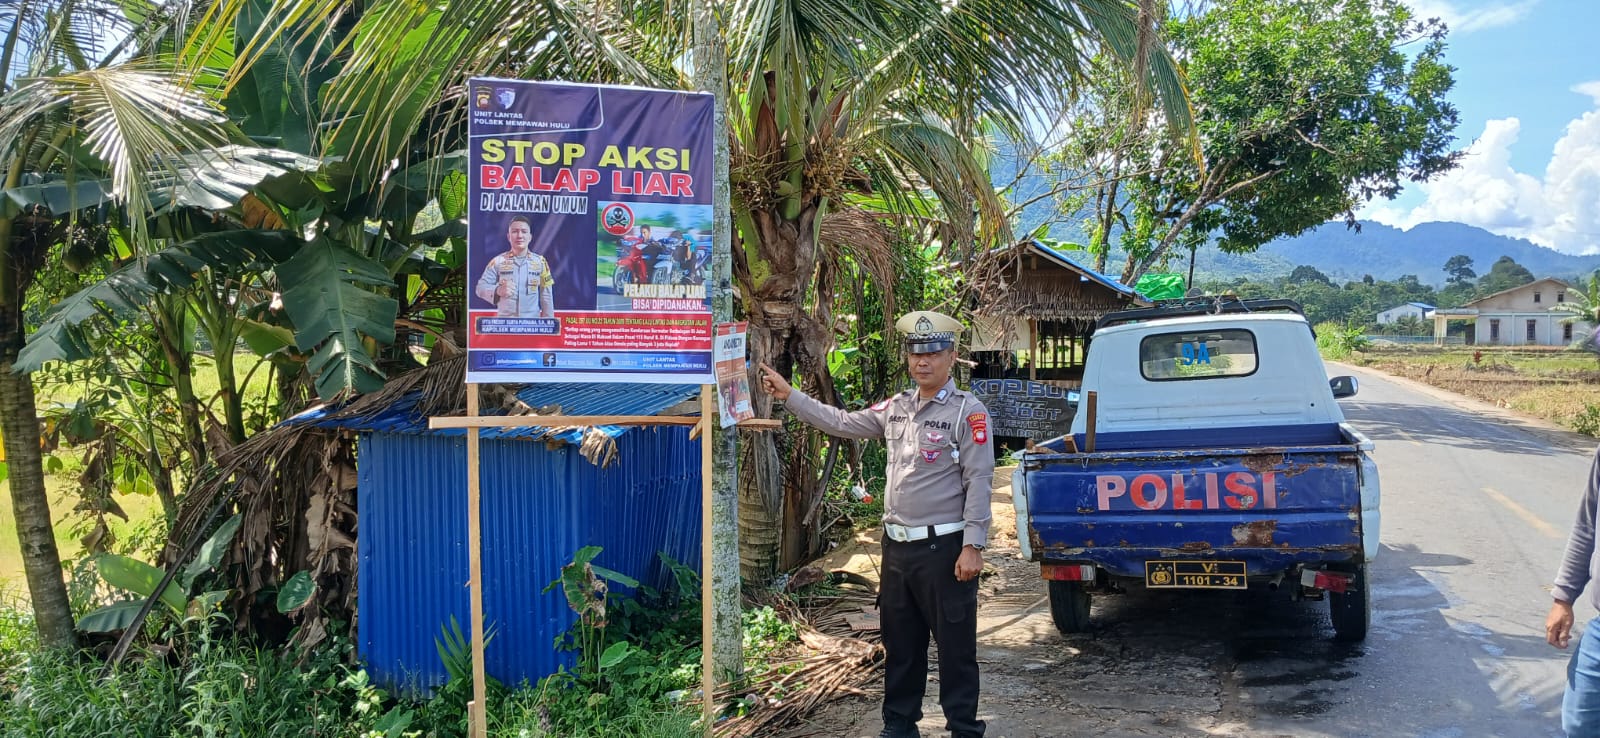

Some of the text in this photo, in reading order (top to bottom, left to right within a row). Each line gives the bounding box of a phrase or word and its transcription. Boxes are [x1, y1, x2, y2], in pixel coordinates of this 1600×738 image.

[481, 138, 690, 171] STOP AKSI
[480, 165, 694, 198] BALAP LIAR
[480, 192, 588, 215] DI JALANAN UMUM
[624, 283, 706, 300] PELAKU BALAP LIAR
[632, 298, 651, 310] BISA
[924, 420, 951, 430] POLRI
[1096, 472, 1276, 510] POLISI
[1183, 576, 1210, 585] 1101
[1223, 576, 1238, 586] 34
